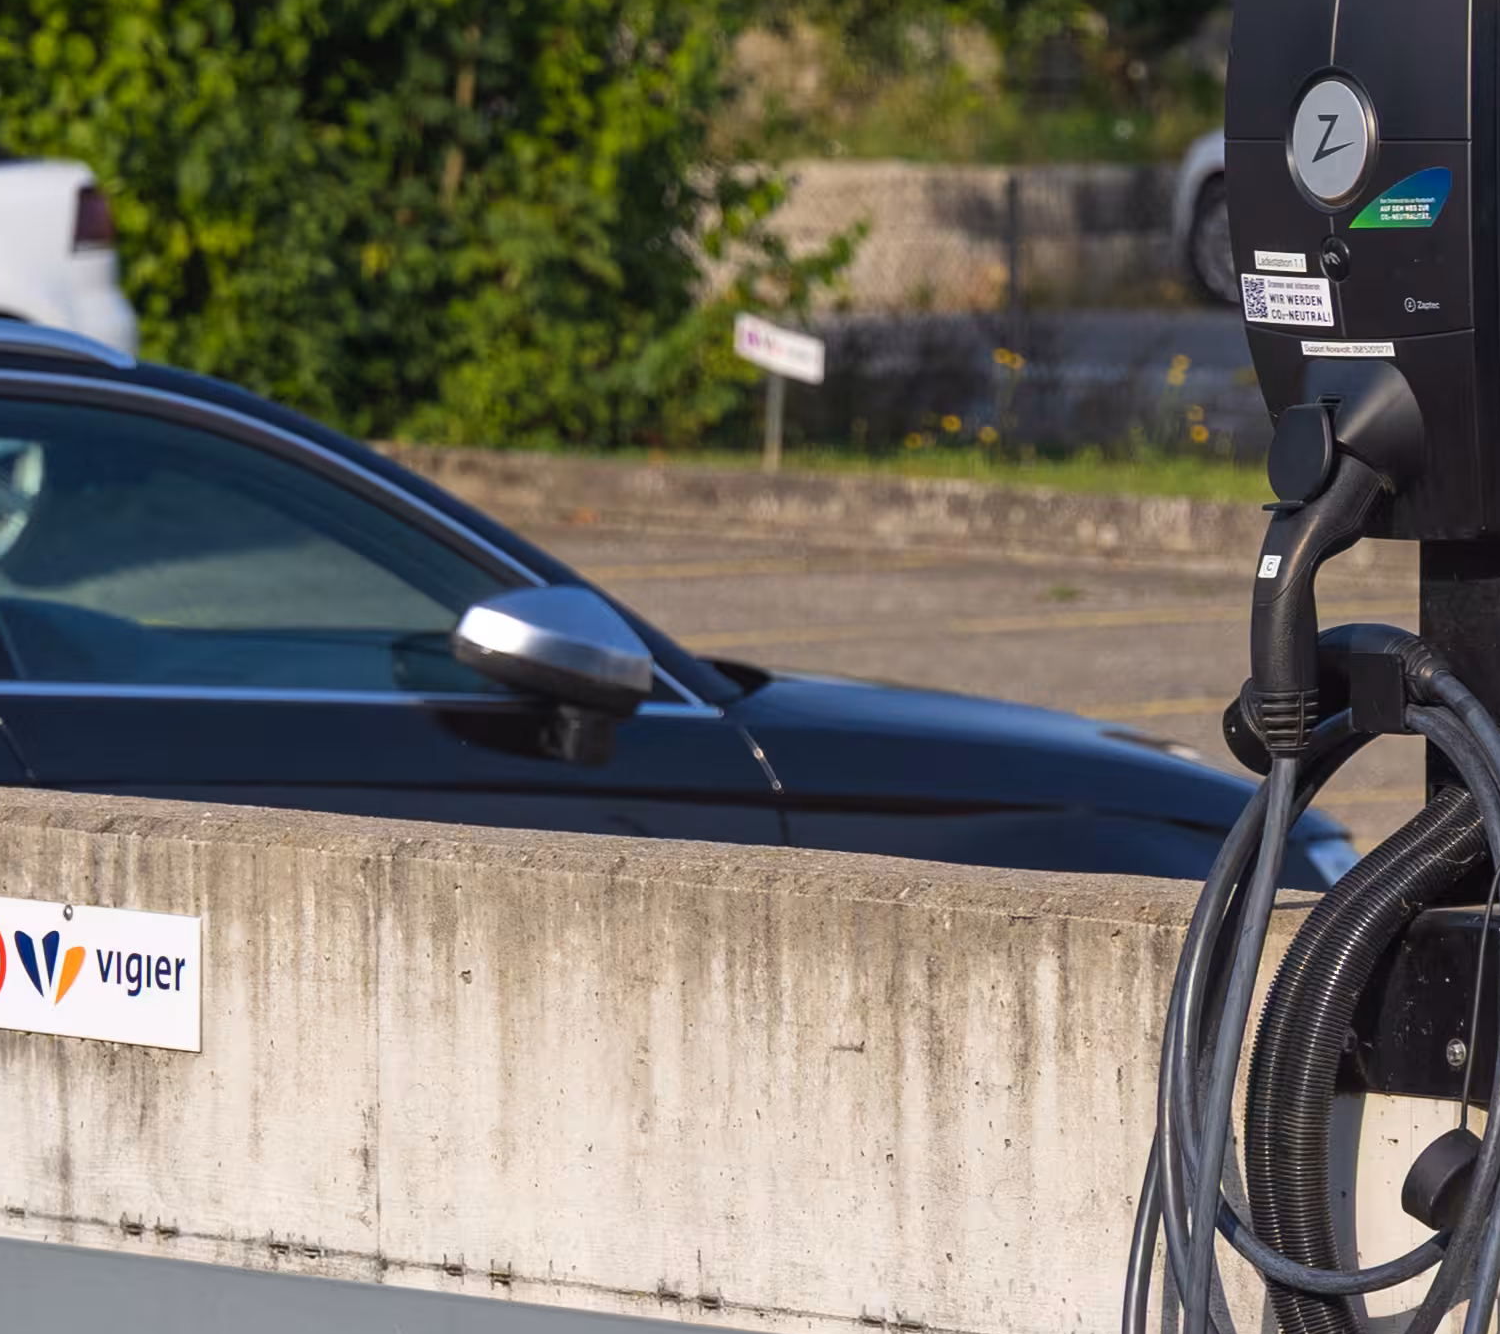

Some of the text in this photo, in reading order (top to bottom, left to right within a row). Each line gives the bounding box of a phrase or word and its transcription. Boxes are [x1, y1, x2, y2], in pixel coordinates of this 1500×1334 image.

[1269, 294, 1322, 306] WIR WERDEN
[96, 949, 186, 997] vigier
